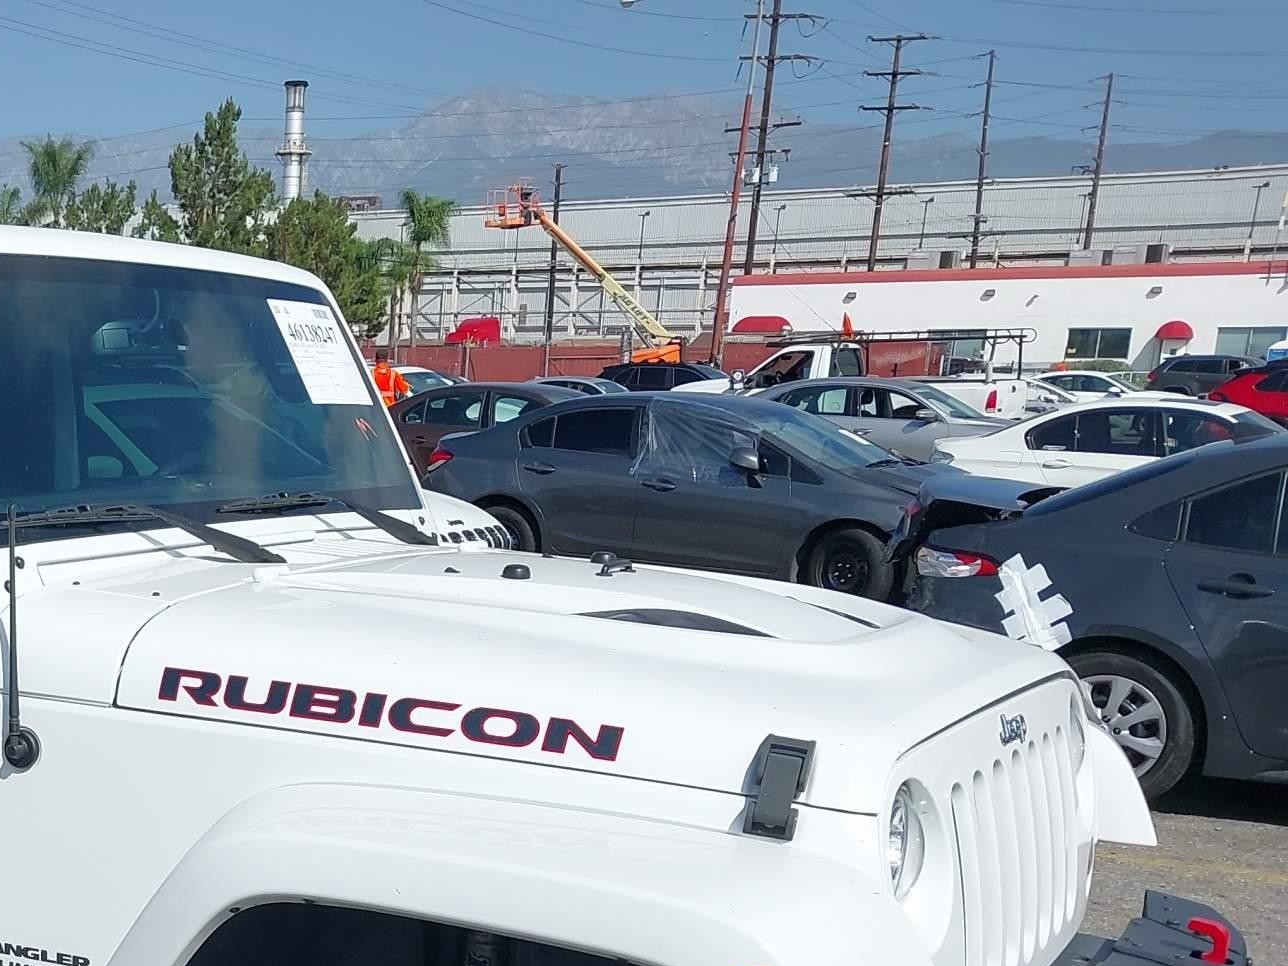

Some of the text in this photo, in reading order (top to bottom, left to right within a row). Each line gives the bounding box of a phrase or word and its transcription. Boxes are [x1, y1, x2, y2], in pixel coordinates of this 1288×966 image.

[287, 322, 338, 344] 46138247
[157, 666, 625, 762] RUBICON
[999, 713, 1027, 747] Jeep
